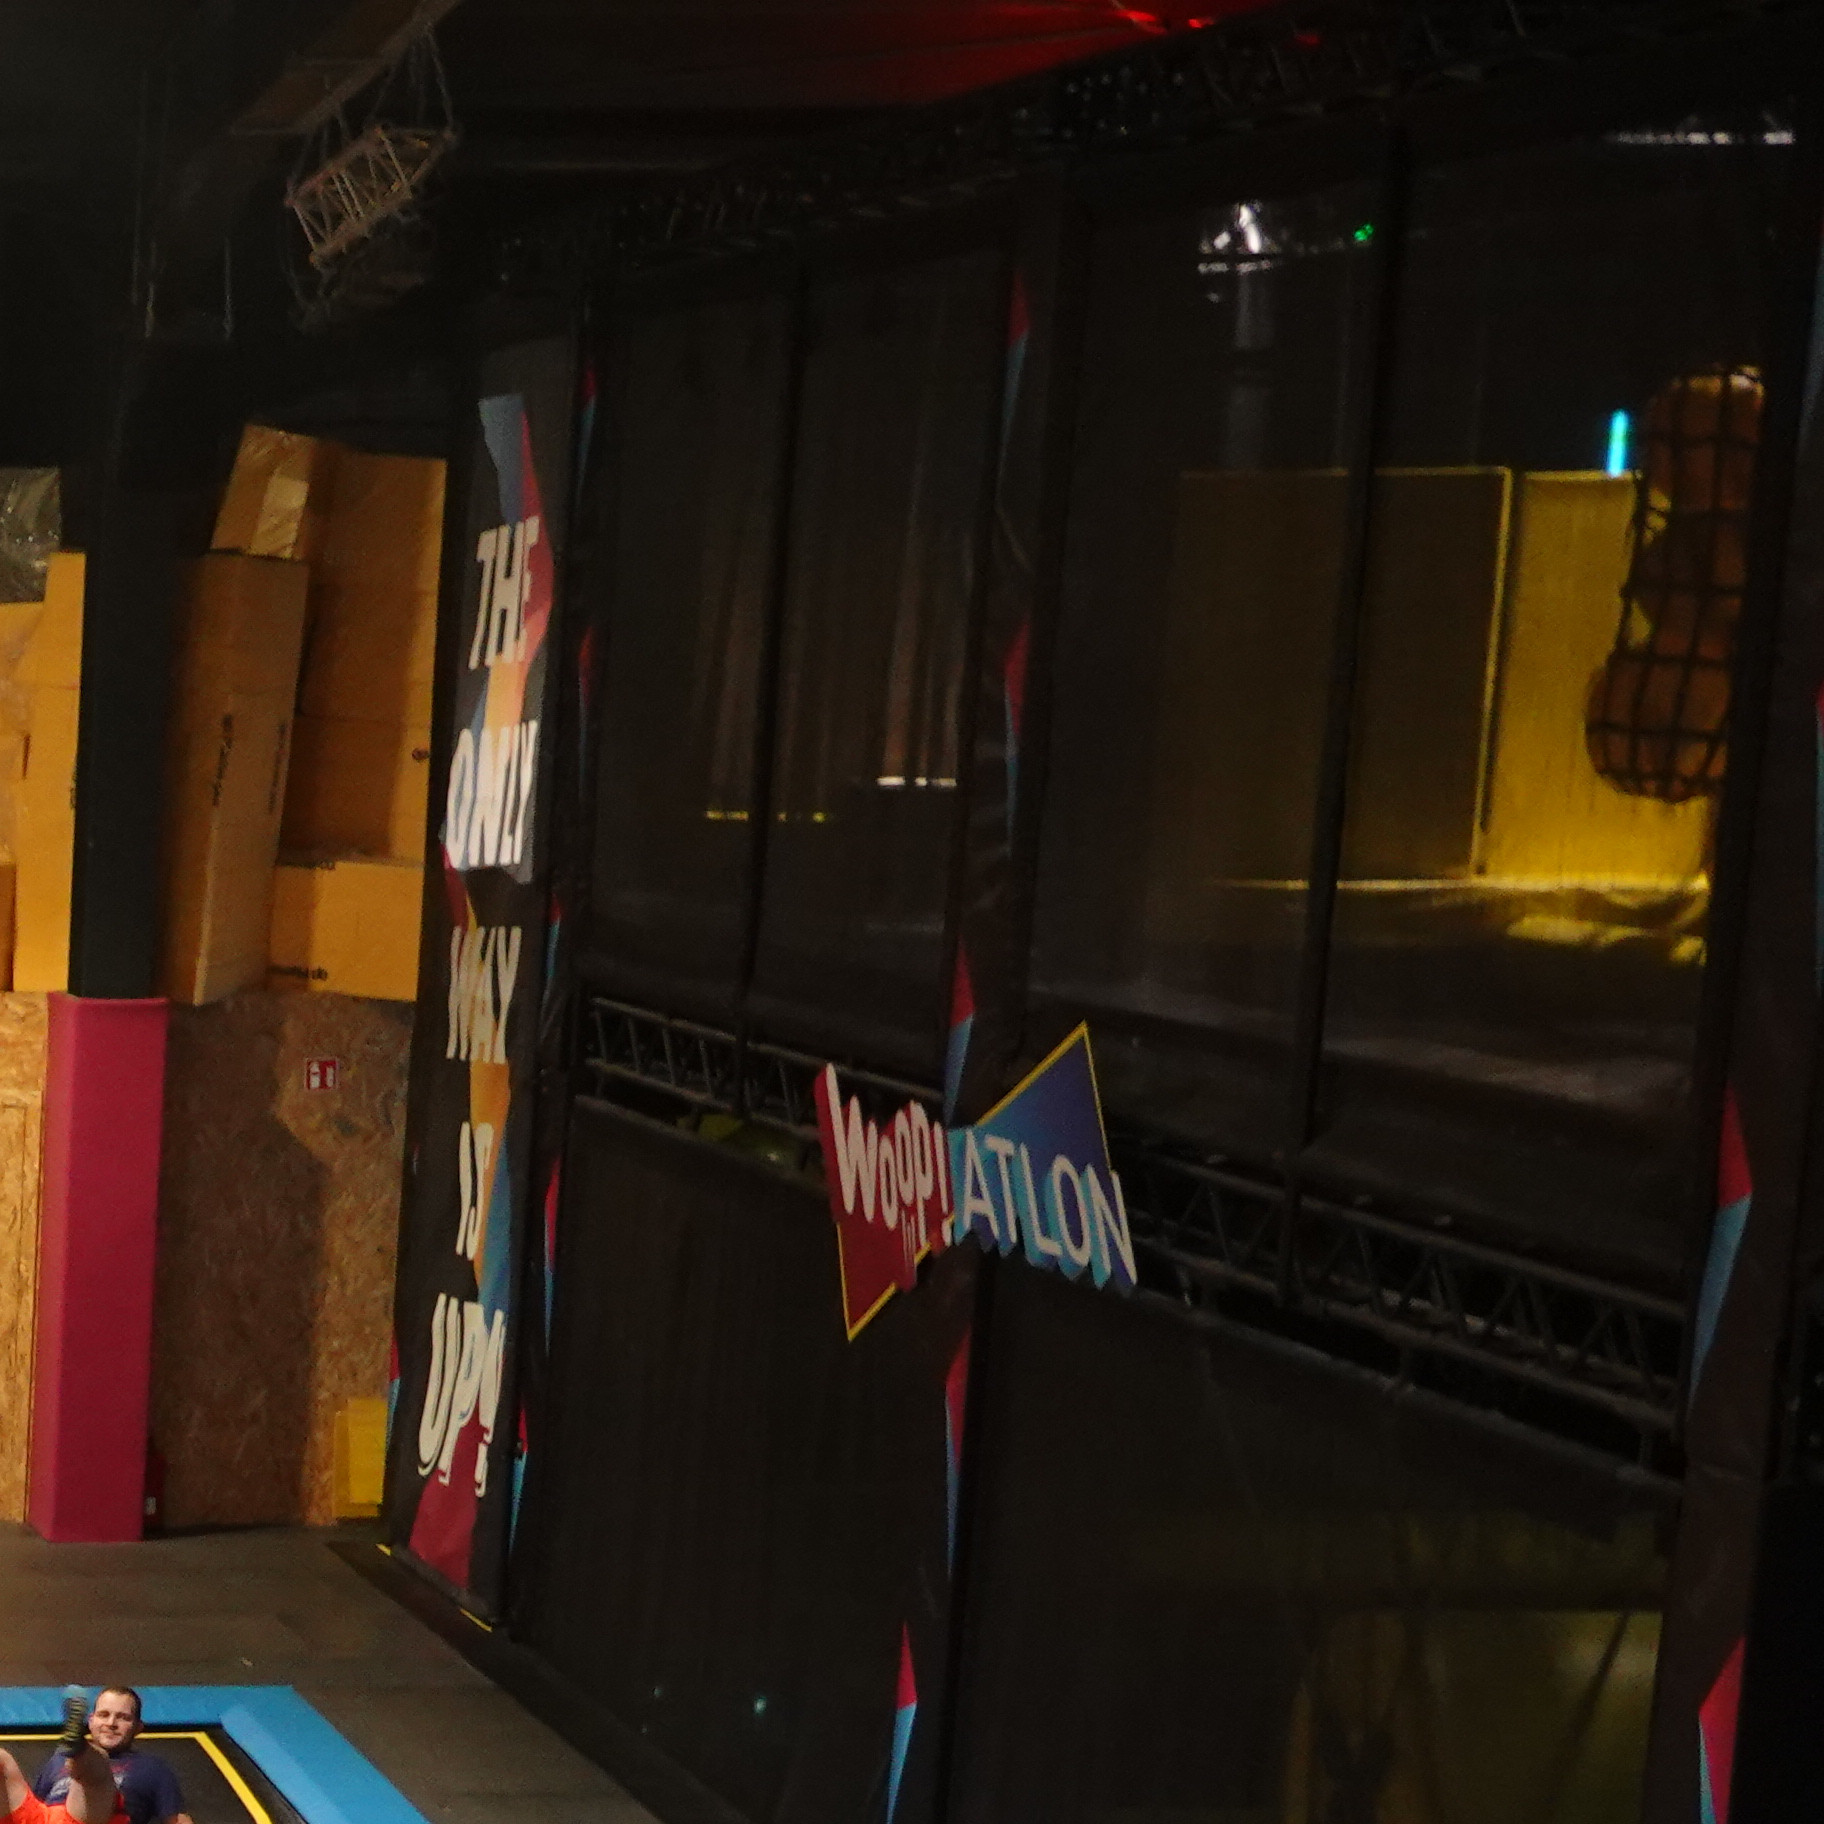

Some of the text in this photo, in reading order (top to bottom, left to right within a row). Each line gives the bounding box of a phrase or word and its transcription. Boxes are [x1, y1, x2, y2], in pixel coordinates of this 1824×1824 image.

[468, 515, 540, 670] THE
[445, 720, 539, 869] ONLY
[446, 925, 522, 1063] WAY
[456, 1121, 495, 1261] IS
[963, 1130, 1138, 1286] ATLON
